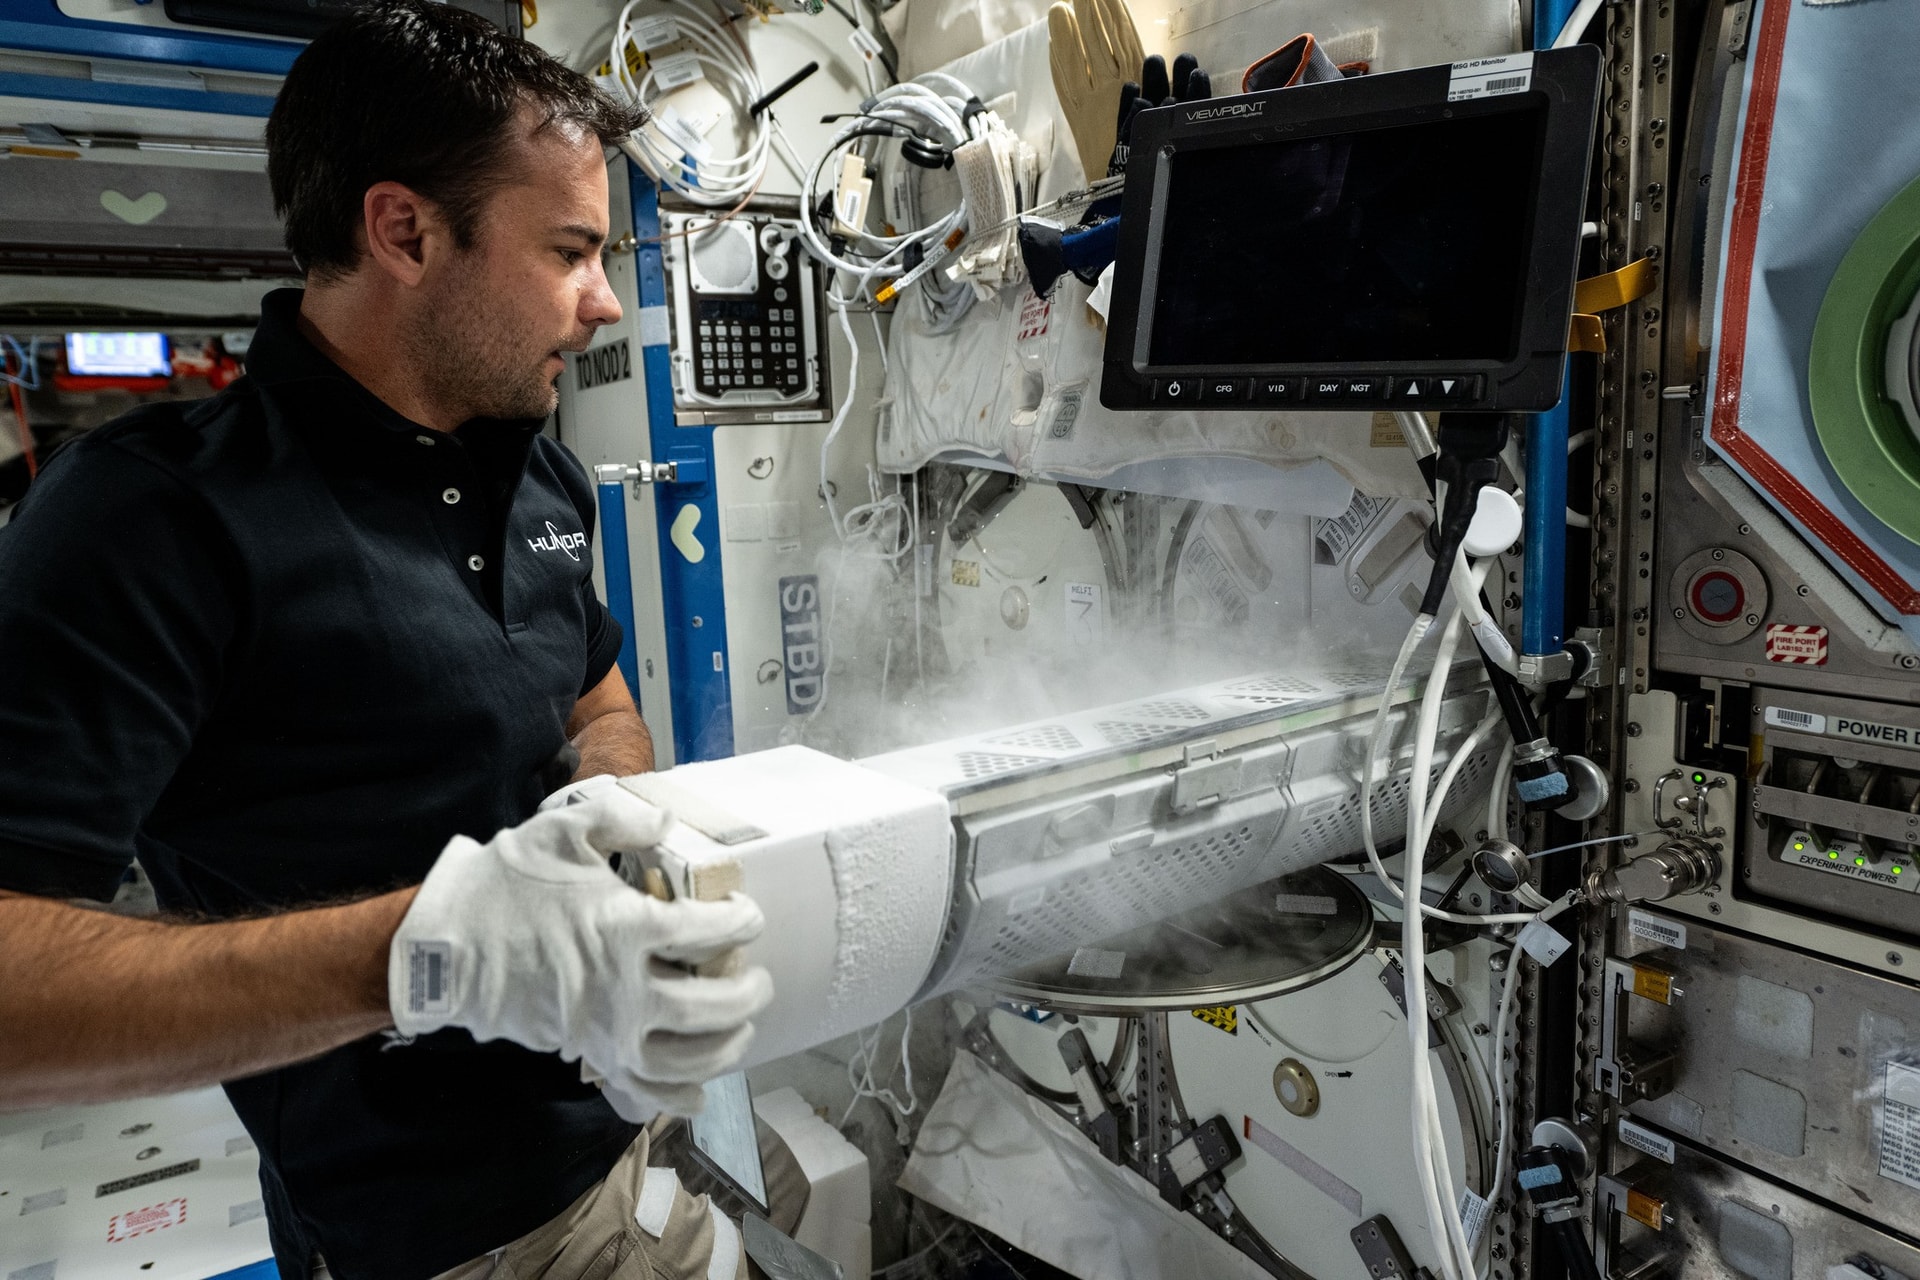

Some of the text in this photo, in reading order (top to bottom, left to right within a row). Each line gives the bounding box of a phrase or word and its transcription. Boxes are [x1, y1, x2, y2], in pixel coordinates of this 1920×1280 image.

[1481, 58, 1507, 66] Monitor
[1186, 101, 1267, 121] VIEWPOINT
[576, 341, 630, 389] TO NOD 2
[1319, 384, 1338, 392] DAY
[1351, 384, 1370, 392] NGT
[528, 525, 587, 558] HUNOR
[782, 582, 822, 706] STBD
[1775, 636, 1817, 646] FIRE PORT
[1838, 719, 1908, 743] POWER
[1890, 857, 1912, 867] +28V
[1799, 854, 1899, 884] EXPERIMENT POWERS
[1634, 926, 1676, 945] 00005119K
[1324, 1071, 1338, 1079] OPEN
[1886, 1100, 1904, 1110] MSG
[1886, 1108, 1904, 1118] MSG
[1886, 1115, 1904, 1126] MSG
[1885, 1123, 1904, 1134] MSG
[1884, 1131, 1903, 1142] MSG
[1884, 1139, 1902, 1150] MSG
[1883, 1147, 1901, 1158] MSG
[1882, 1155, 1901, 1166] MSG
[1881, 1163, 1904, 1176] Video
